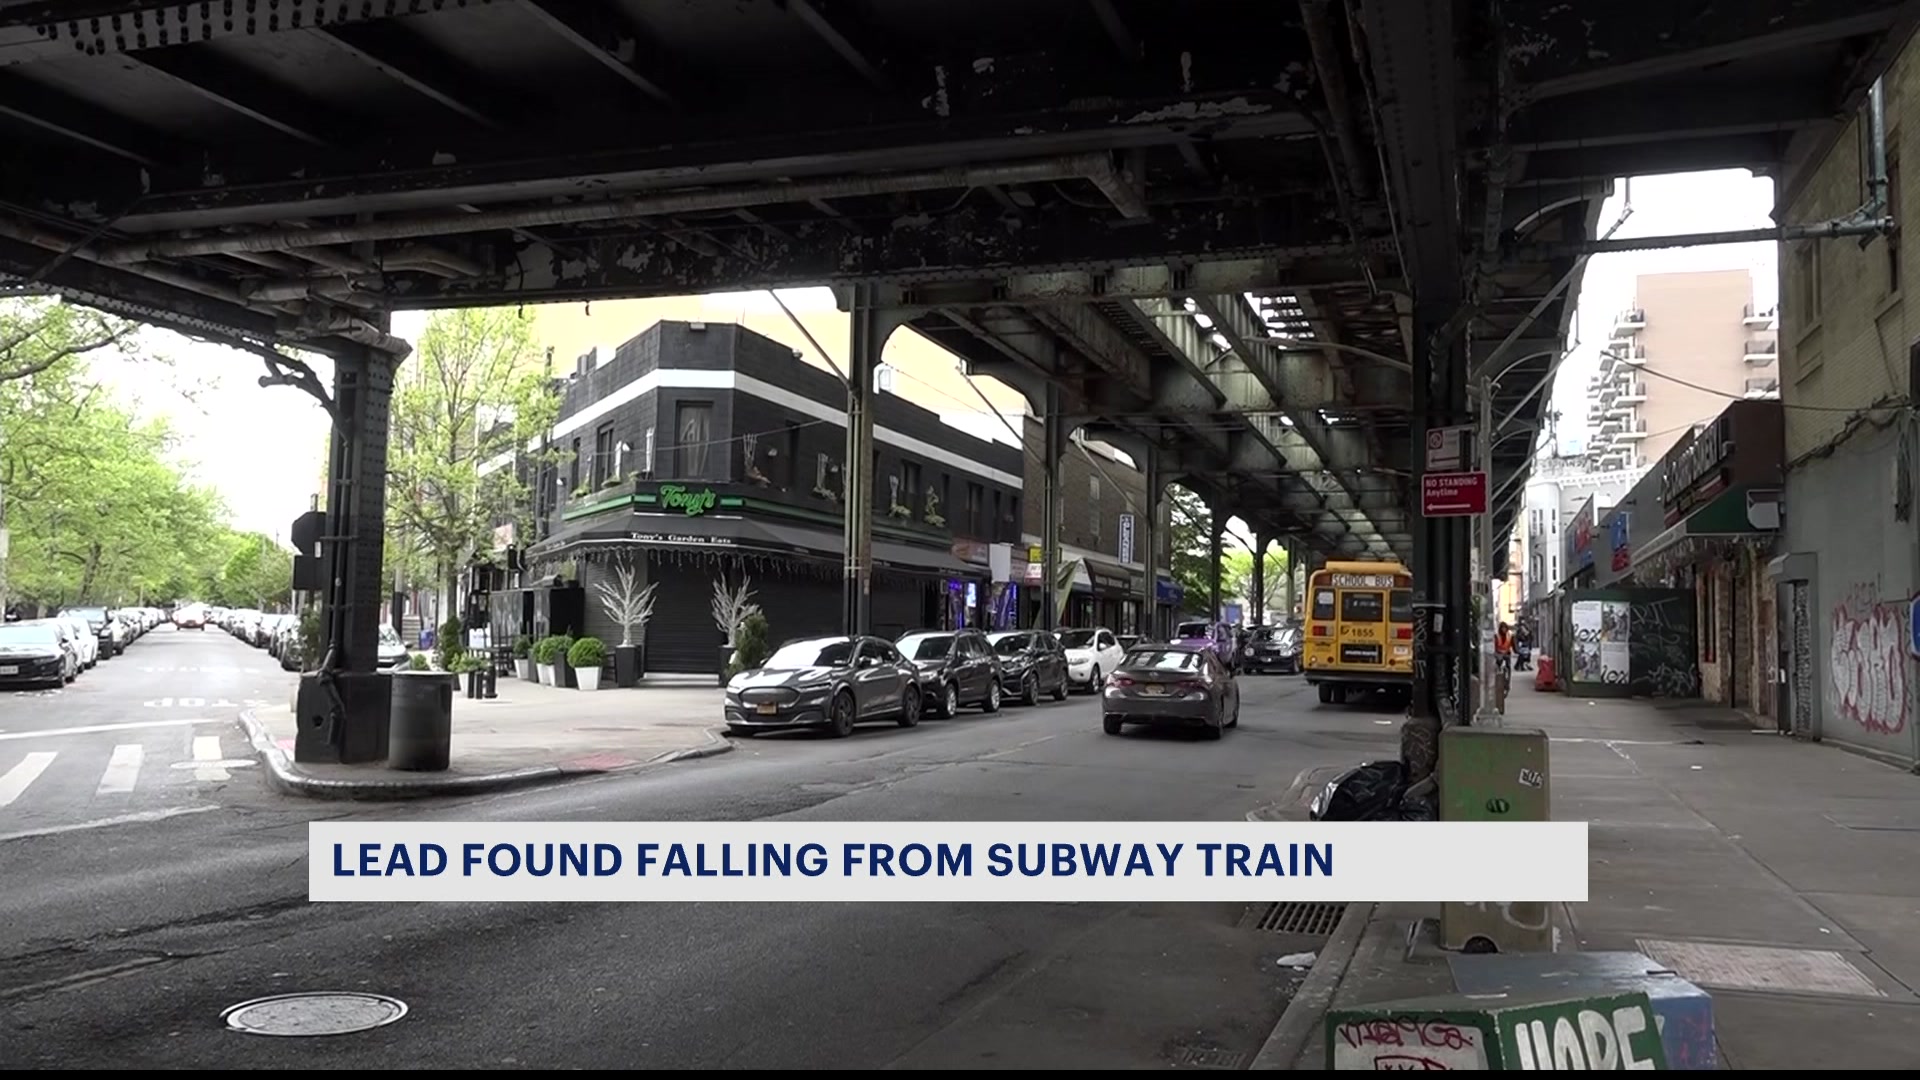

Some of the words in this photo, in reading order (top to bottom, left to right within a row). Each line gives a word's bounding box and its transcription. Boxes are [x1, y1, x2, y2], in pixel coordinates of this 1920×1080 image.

[1425, 479, 1438, 488] NO
[1439, 477, 1478, 487] STANDING
[1426, 488, 1458, 498] Anytime
[660, 484, 716, 517] Tony's
[631, 532, 663, 542] Tony's
[668, 534, 705, 543] Garden
[711, 536, 731, 544] Eats
[1332, 574, 1369, 587] SCHOOL
[1375, 575, 1393, 587] BUS
[1351, 627, 1374, 637] 1855
